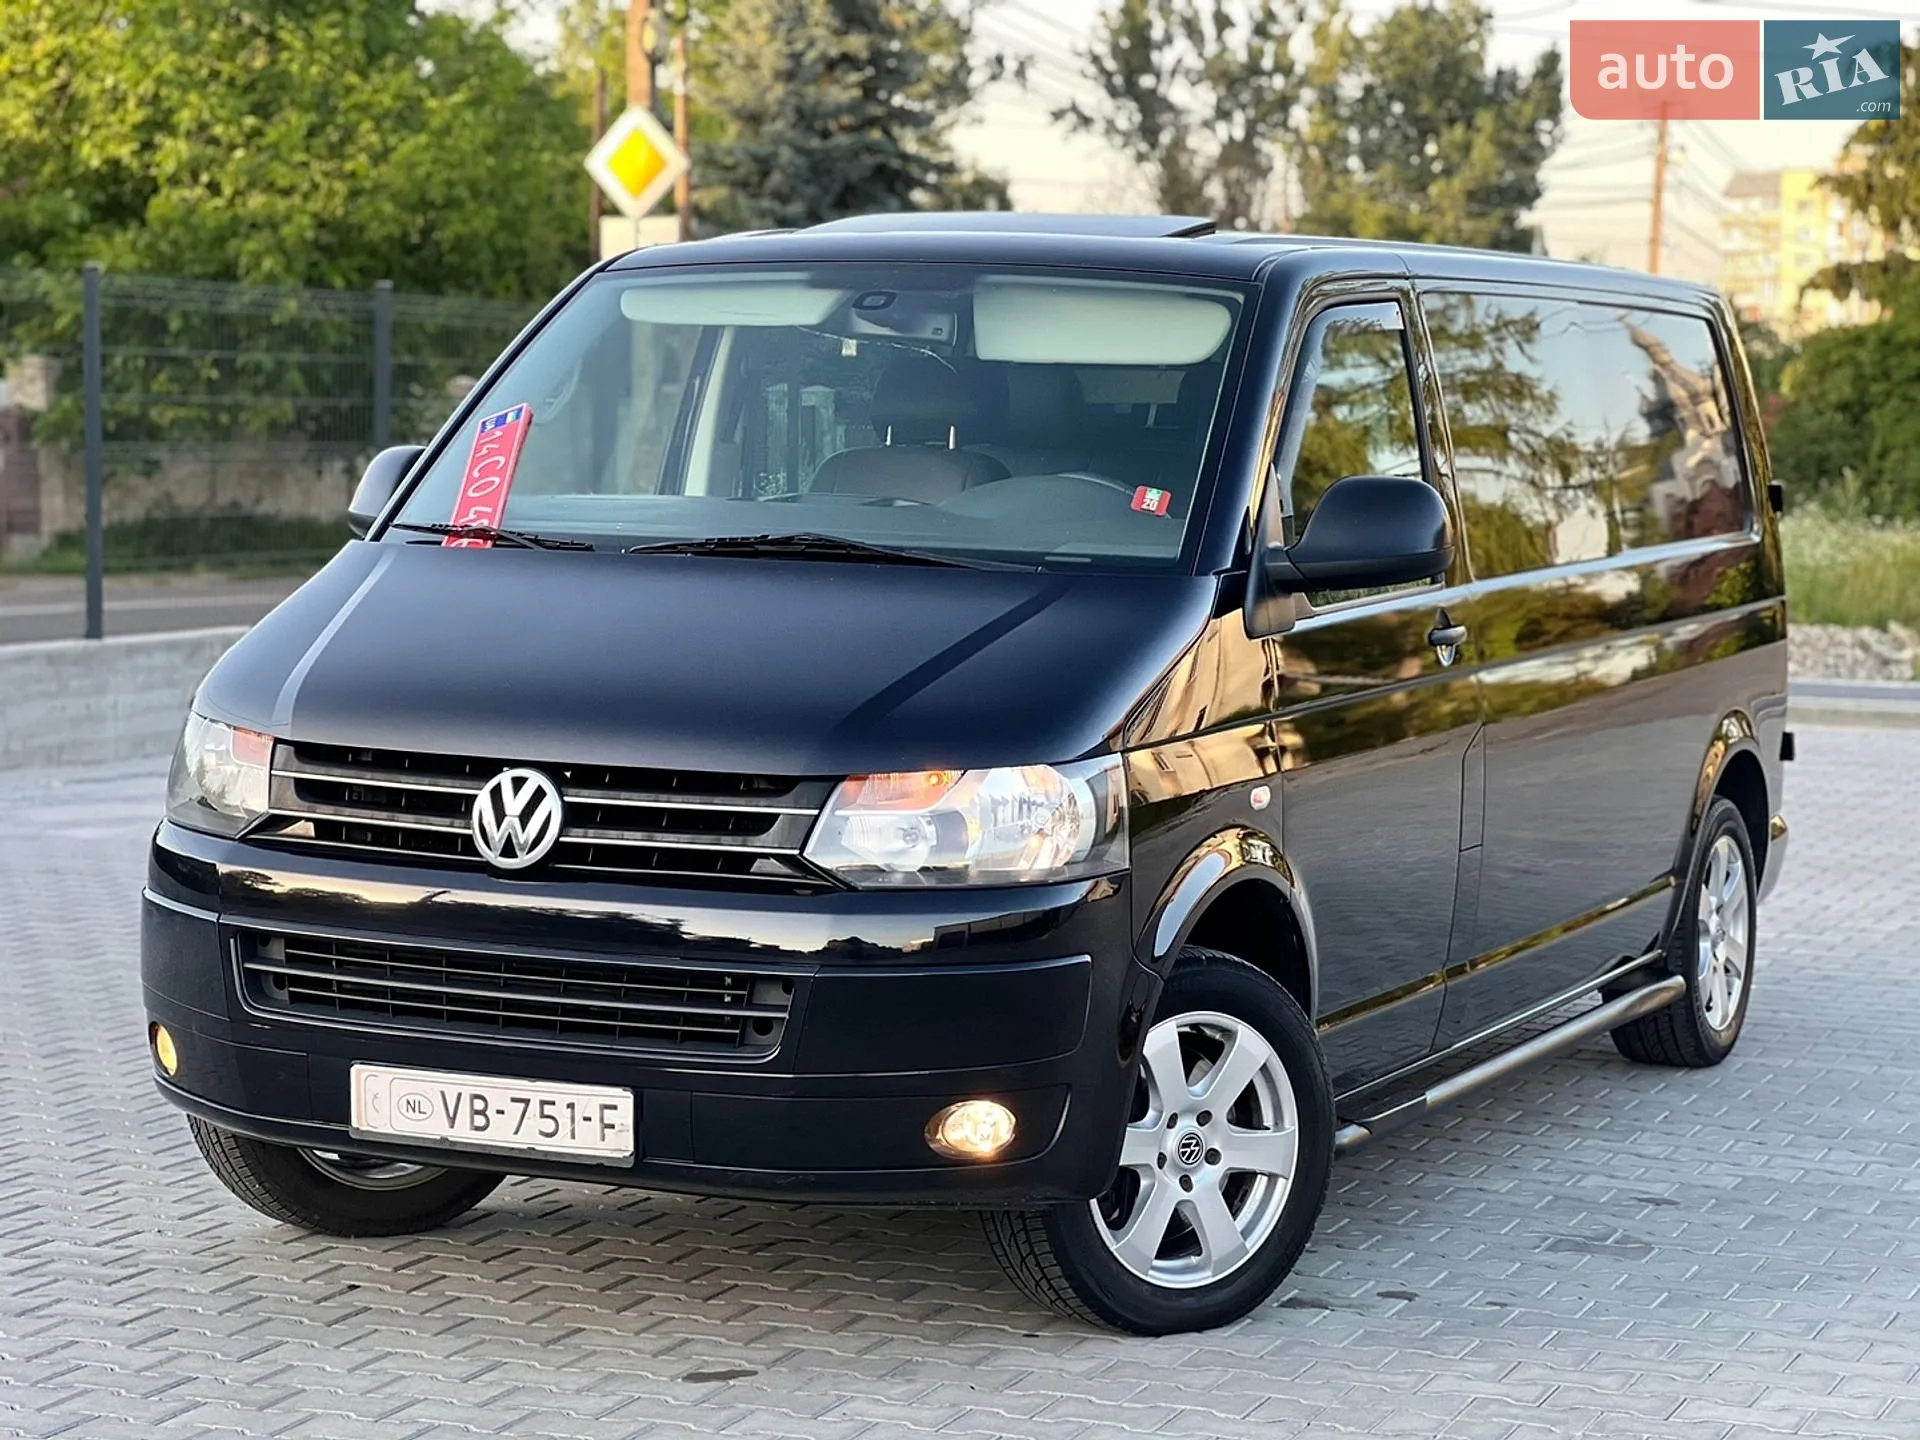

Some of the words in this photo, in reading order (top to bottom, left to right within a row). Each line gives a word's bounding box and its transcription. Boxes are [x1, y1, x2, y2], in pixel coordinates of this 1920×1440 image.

[475, 771, 558, 865] VW
[405, 1099, 427, 1115] NL
[440, 1090, 618, 1142] VB-751-F
